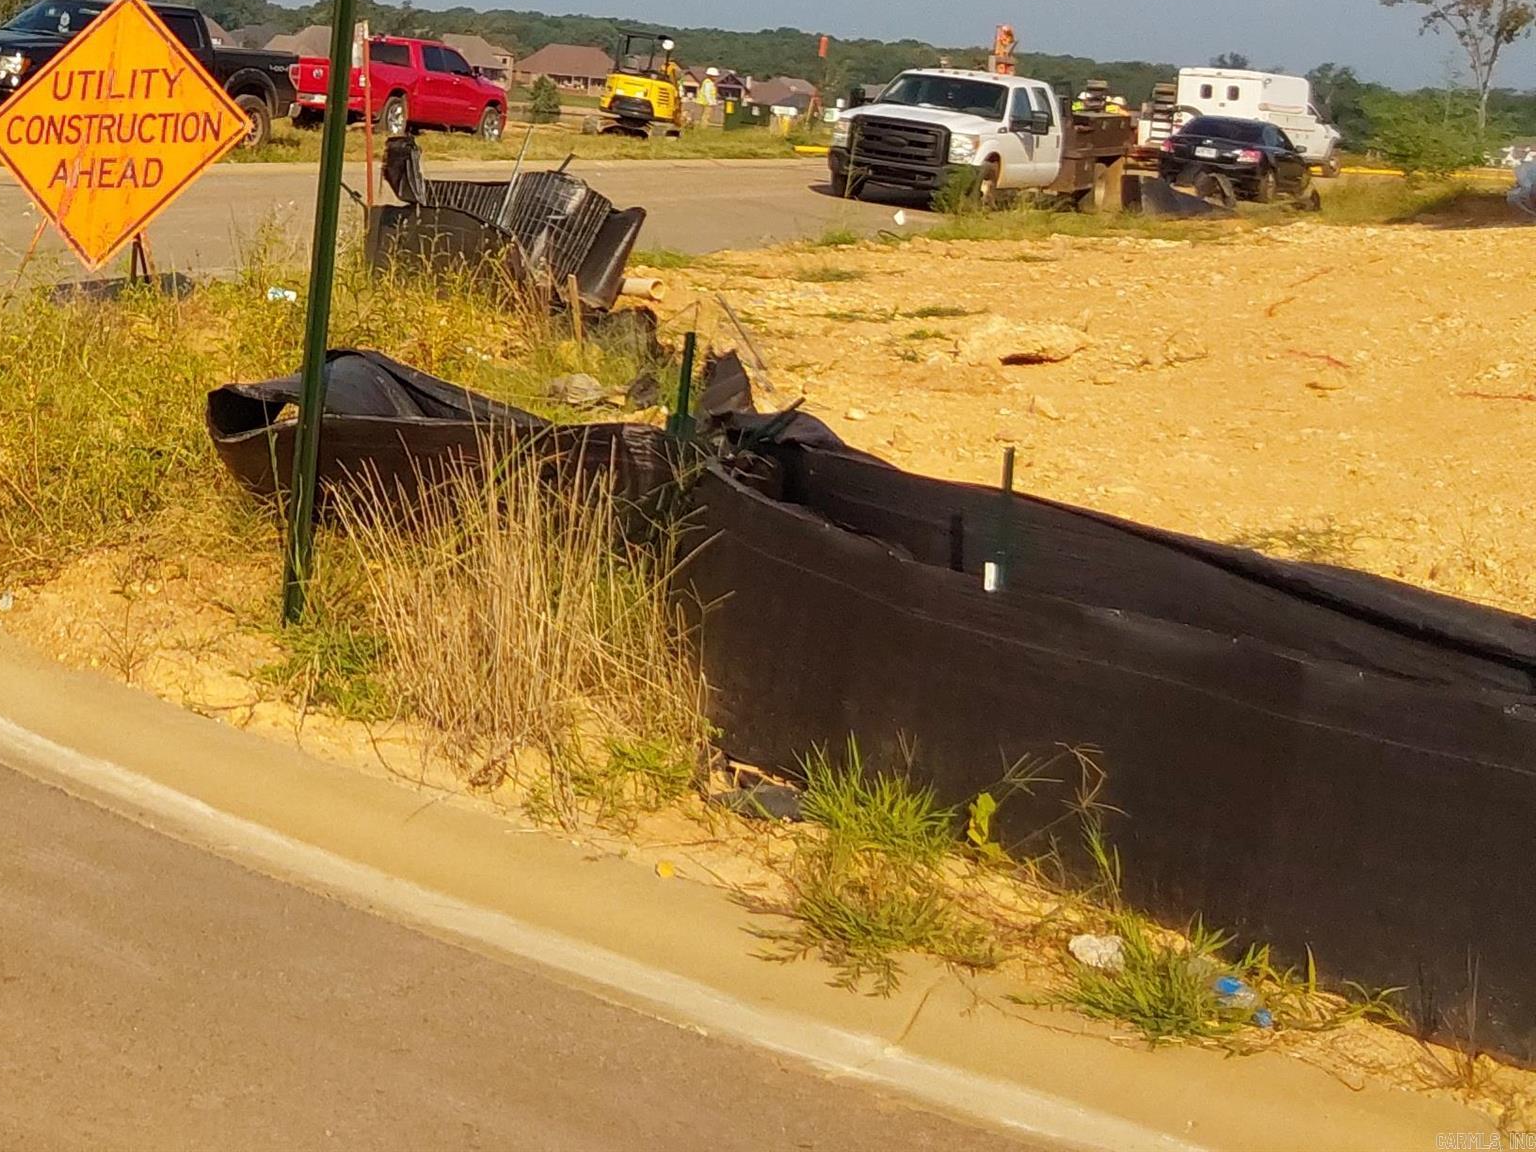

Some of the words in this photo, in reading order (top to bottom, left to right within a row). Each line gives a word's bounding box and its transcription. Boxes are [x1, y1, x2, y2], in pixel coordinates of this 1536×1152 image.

[52, 67, 186, 101] UTILITY
[6, 111, 223, 146] CONSTRUCTION
[47, 157, 164, 190] AHEAD
